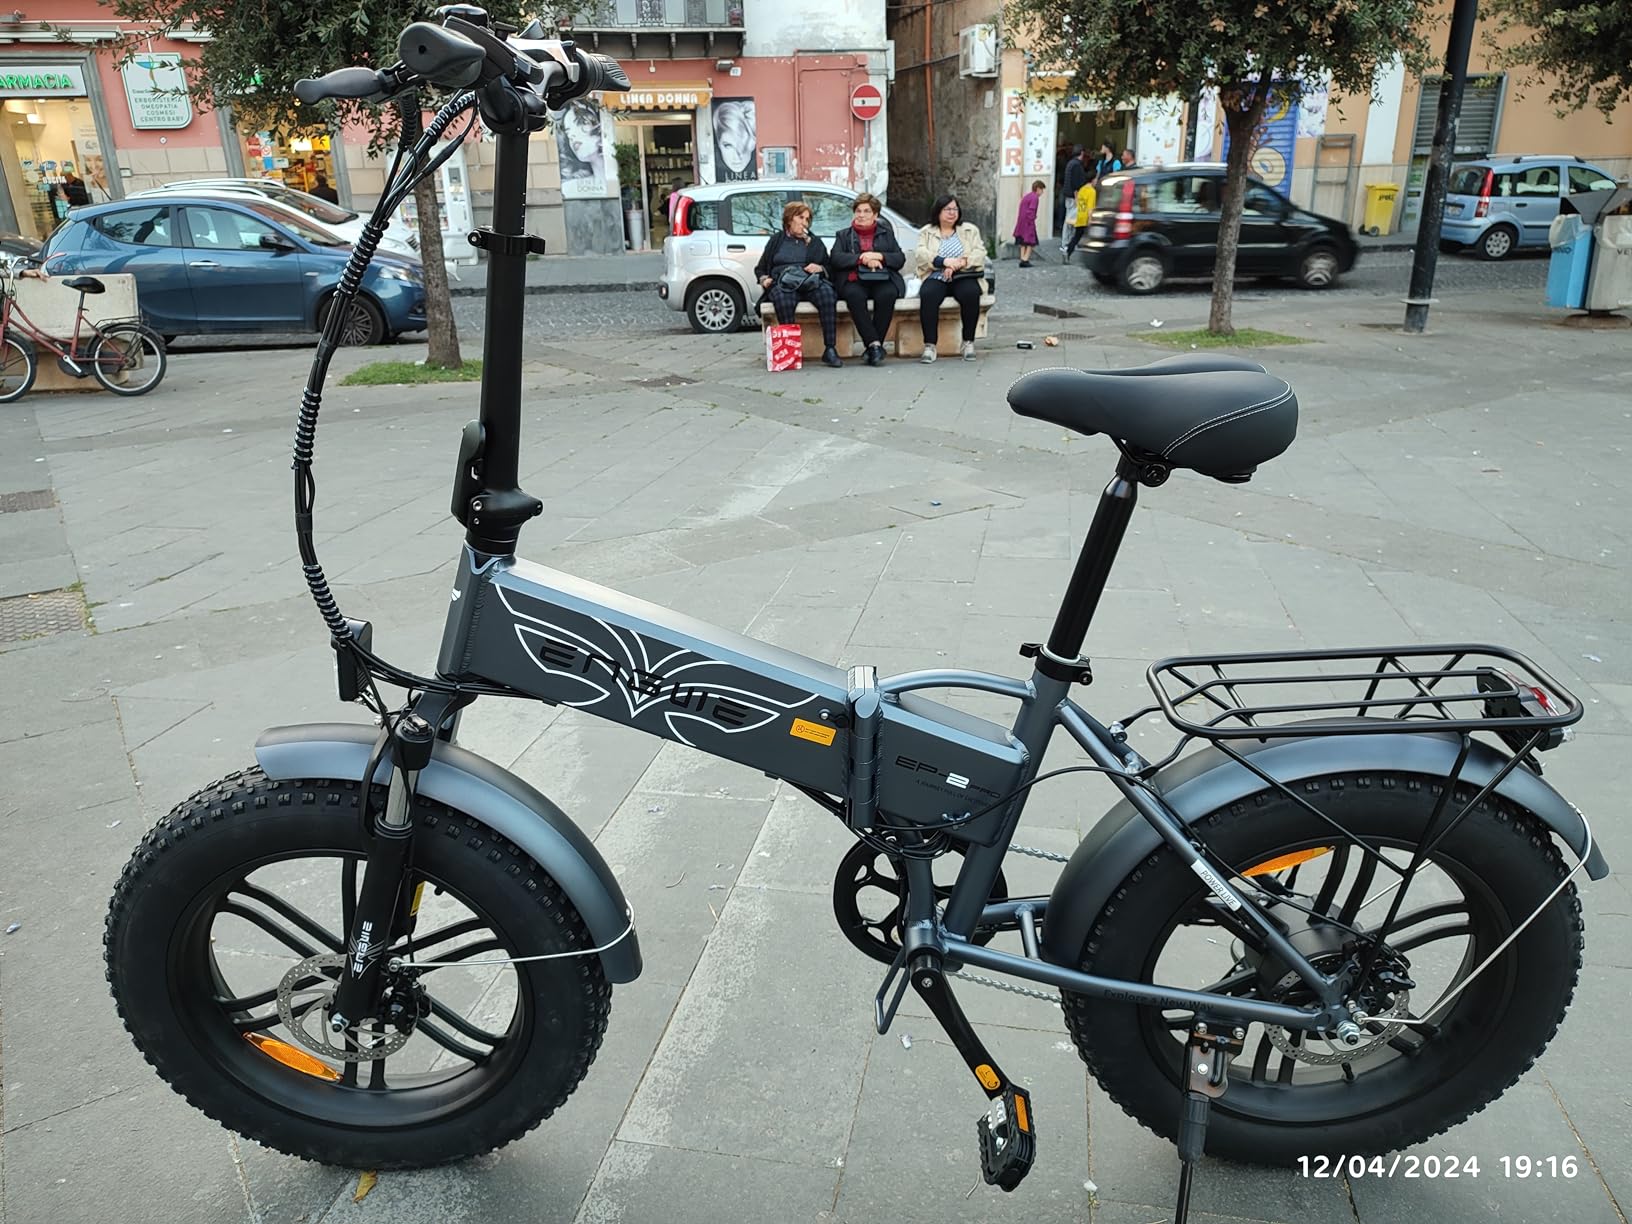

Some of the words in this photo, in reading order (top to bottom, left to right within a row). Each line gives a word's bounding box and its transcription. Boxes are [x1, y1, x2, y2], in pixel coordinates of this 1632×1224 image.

[620, 93, 653, 105] LINEA
[657, 92, 698, 104] DONNA
[1005, 96, 1024, 167] BAR
[724, 171, 757, 181] LINEA
[539, 638, 749, 727] ENGWE
[1200, 870, 1224, 893] POWER
[1220, 891, 1236, 906] LIVE
